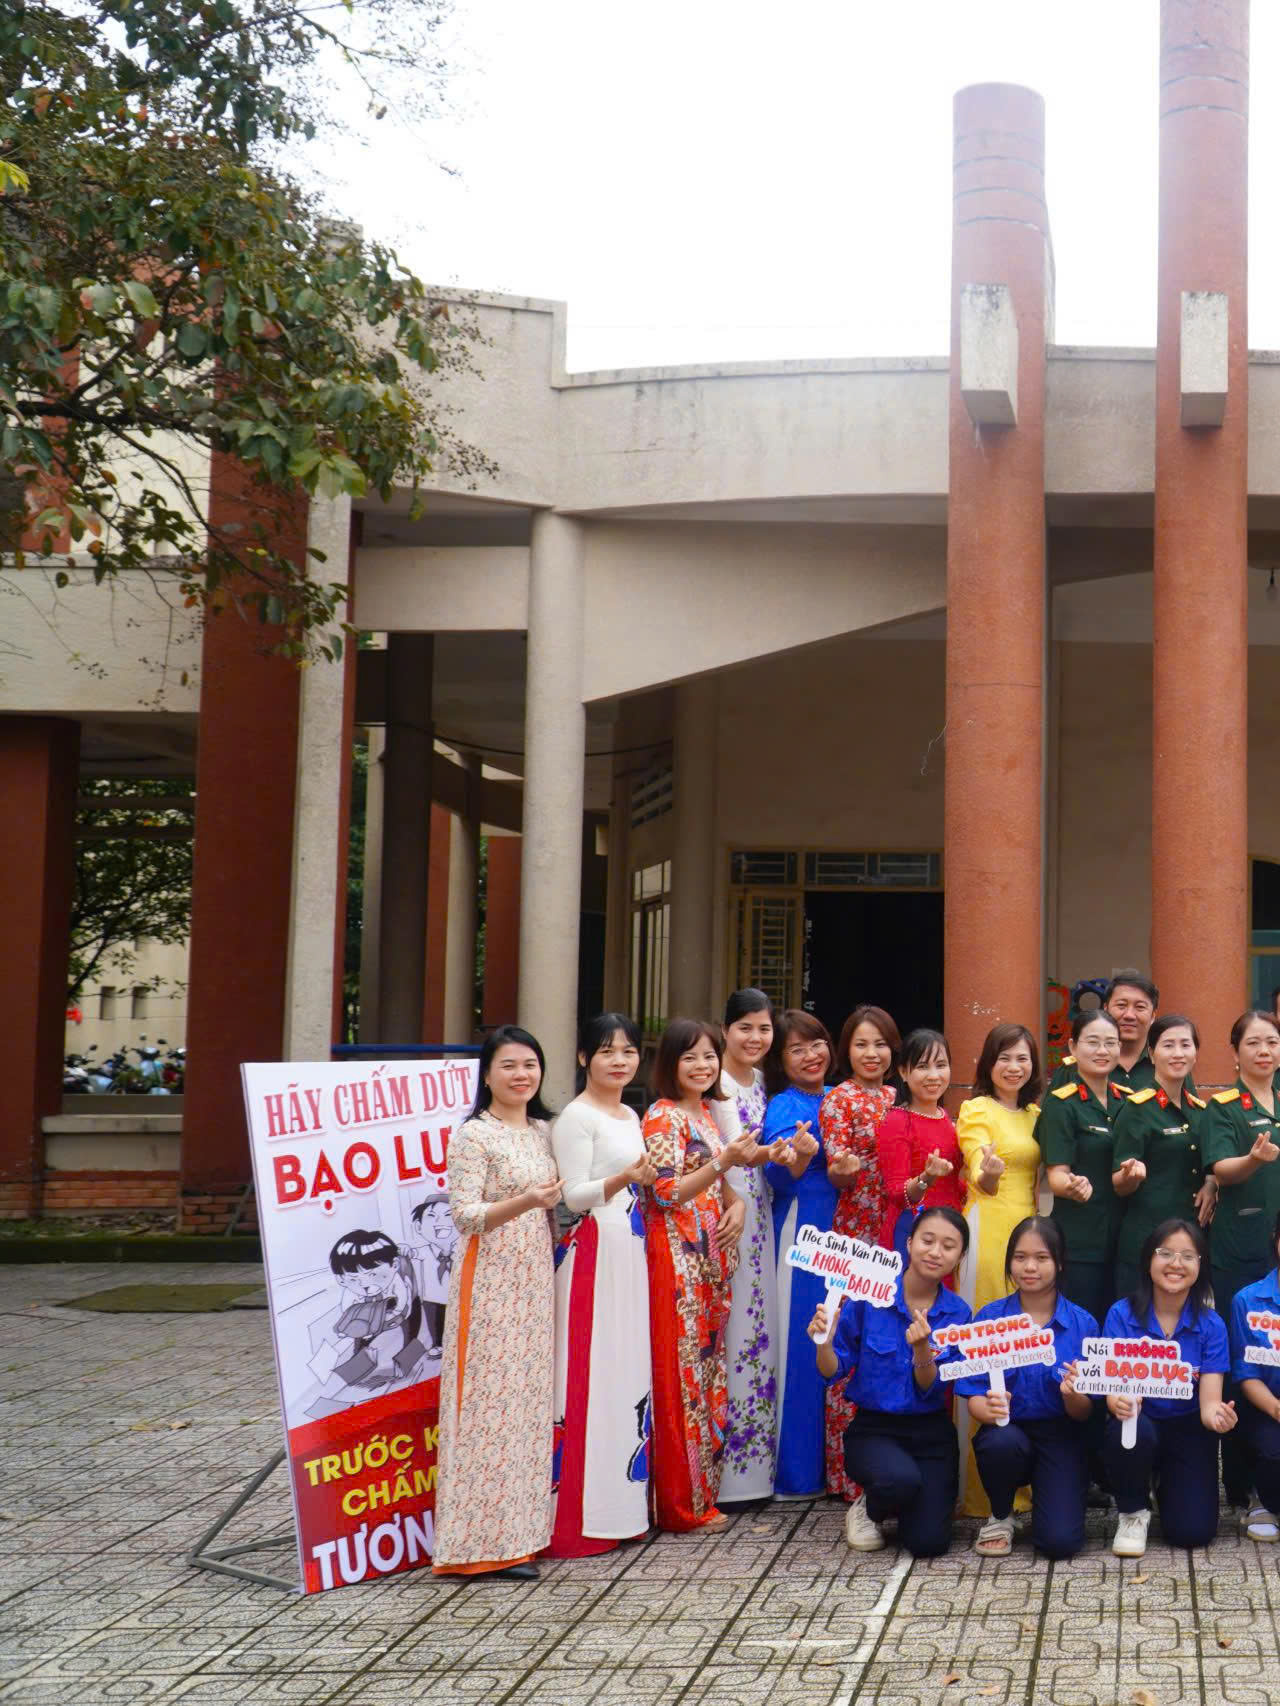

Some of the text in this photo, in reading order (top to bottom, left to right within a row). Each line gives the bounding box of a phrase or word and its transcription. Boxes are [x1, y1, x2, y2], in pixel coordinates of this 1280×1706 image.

[264, 1060, 472, 1137] HÃY CHẤM DỨT
[273, 1125, 452, 1211] BẠO LỰ
[825, 1236, 848, 1254] Sinh
[872, 1250, 898, 1270] Minh
[936, 1317, 1030, 1345] TÔN TRỌNG
[965, 1339, 1011, 1360] THẤU
[1087, 1340, 1177, 1360] Nói KHÔNG
[1082, 1360, 1189, 1385] với BẠO LỰC
[304, 1434, 415, 1487] TRƯỚC
[342, 1461, 439, 1516] CHẤM
[312, 1510, 435, 1590] TƯƠN
